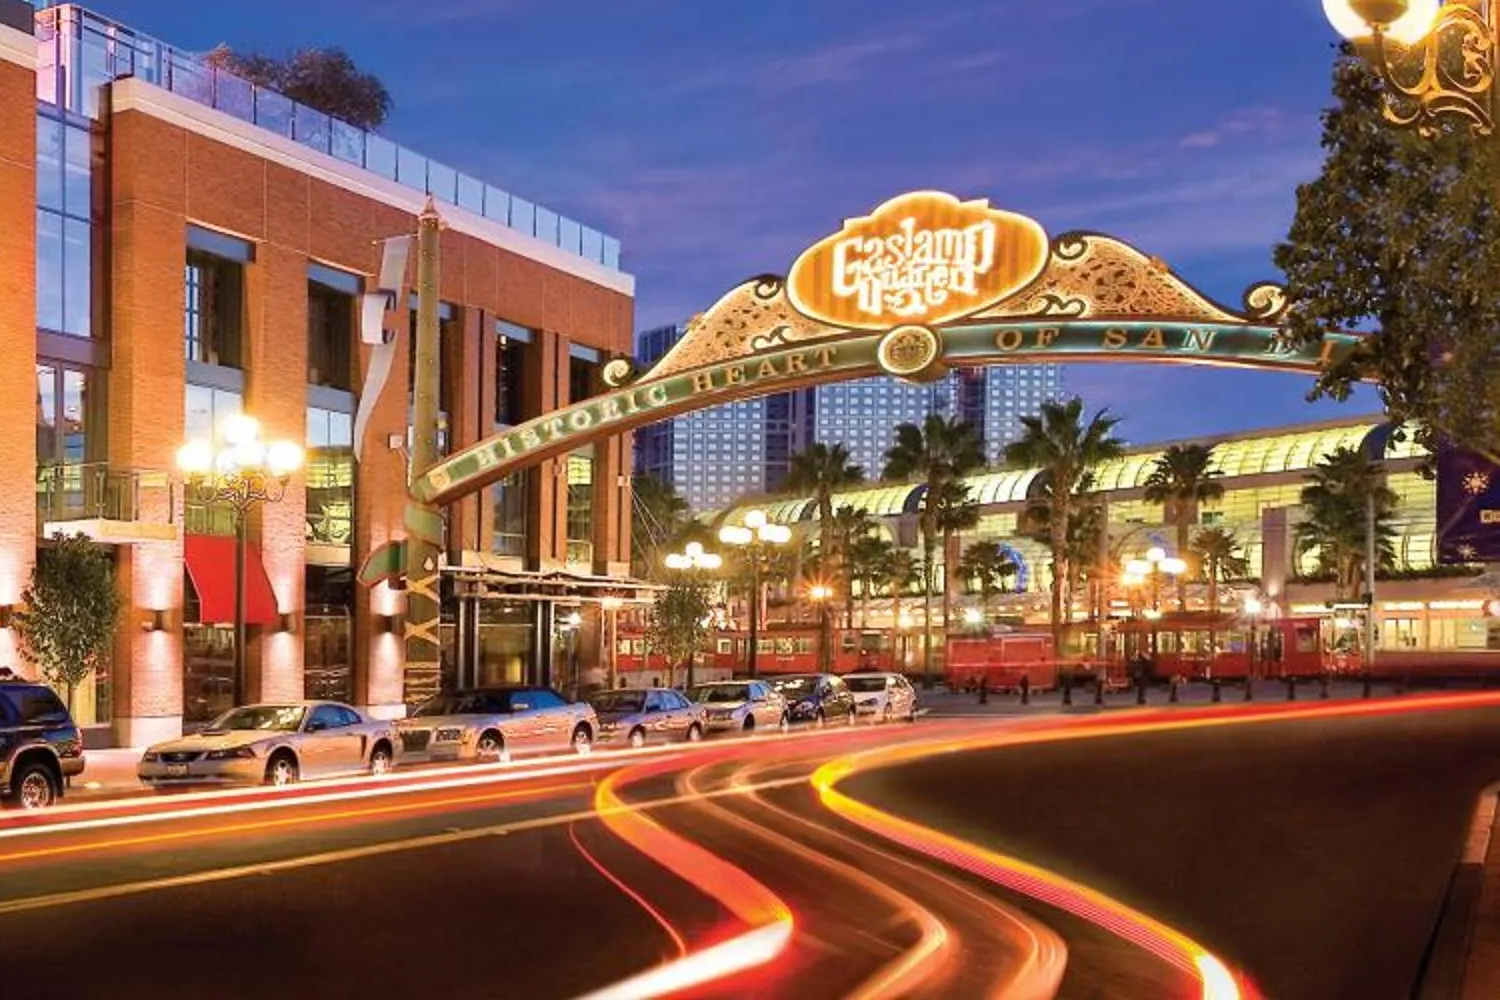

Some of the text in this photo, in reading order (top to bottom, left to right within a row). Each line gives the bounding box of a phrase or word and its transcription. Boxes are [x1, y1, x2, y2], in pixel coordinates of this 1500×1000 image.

[476, 327, 1218, 469] HISTORIC HEART OF SAN
